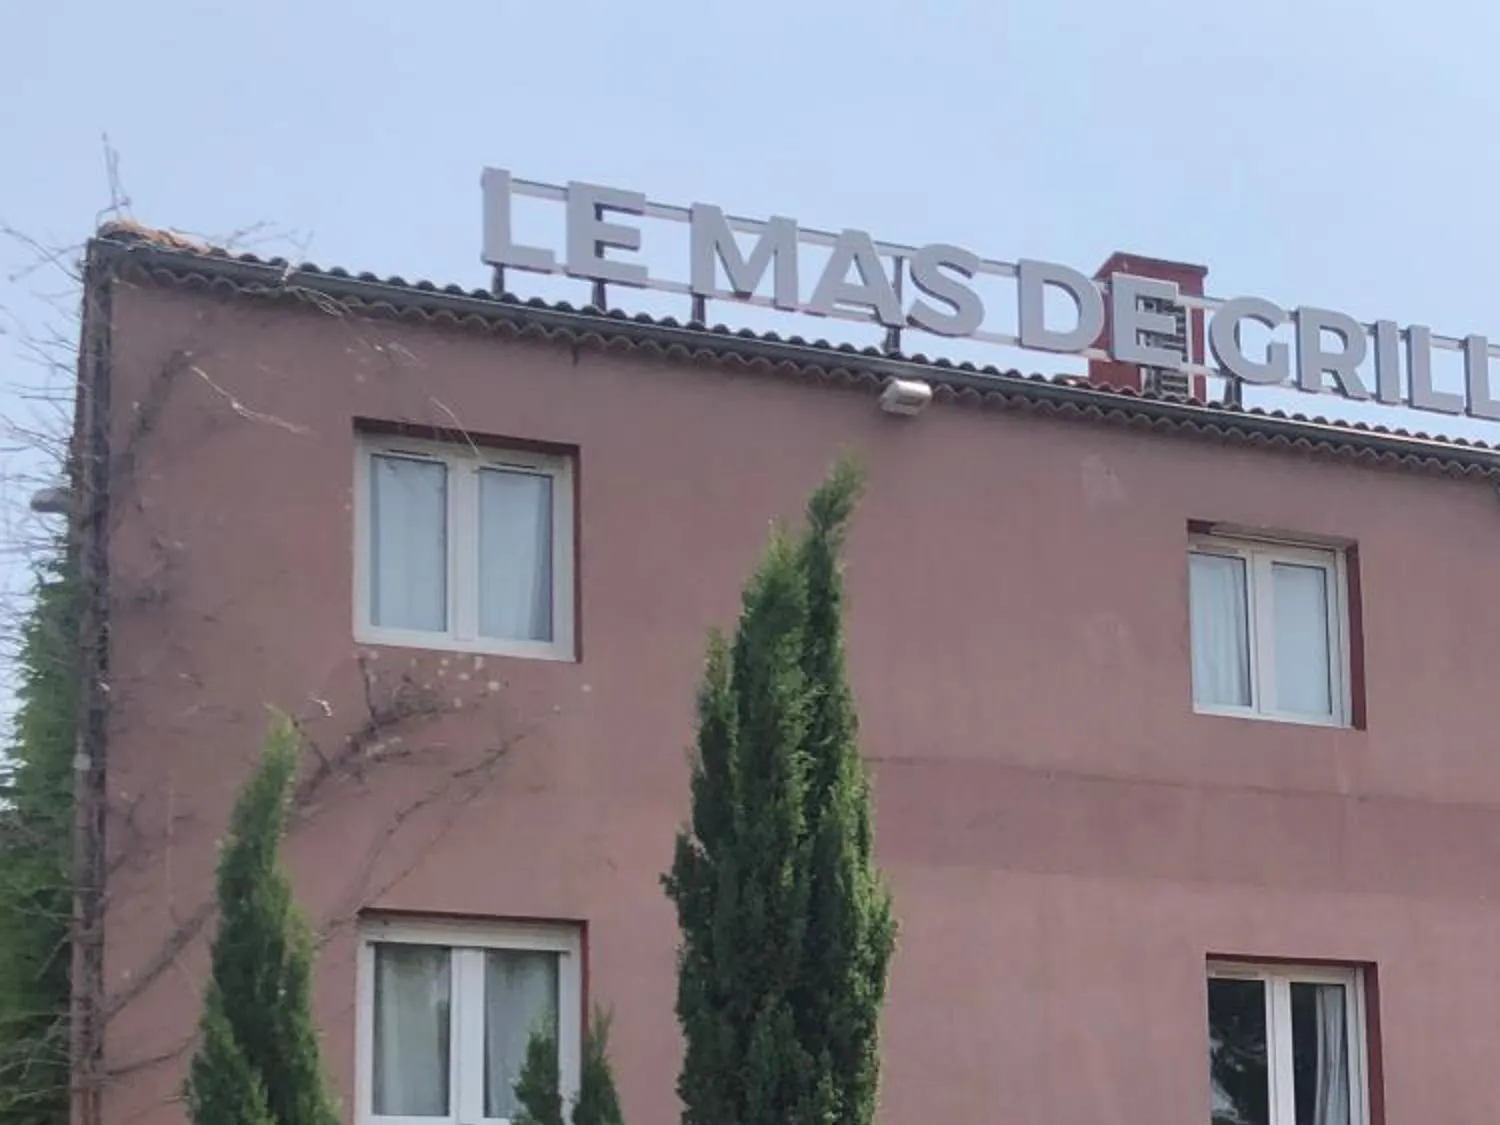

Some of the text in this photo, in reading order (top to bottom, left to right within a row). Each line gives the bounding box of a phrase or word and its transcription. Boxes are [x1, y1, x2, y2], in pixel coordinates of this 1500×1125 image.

[480, 166, 648, 287] LE
[690, 201, 985, 337] MAS
[1017, 258, 1183, 369] DE
